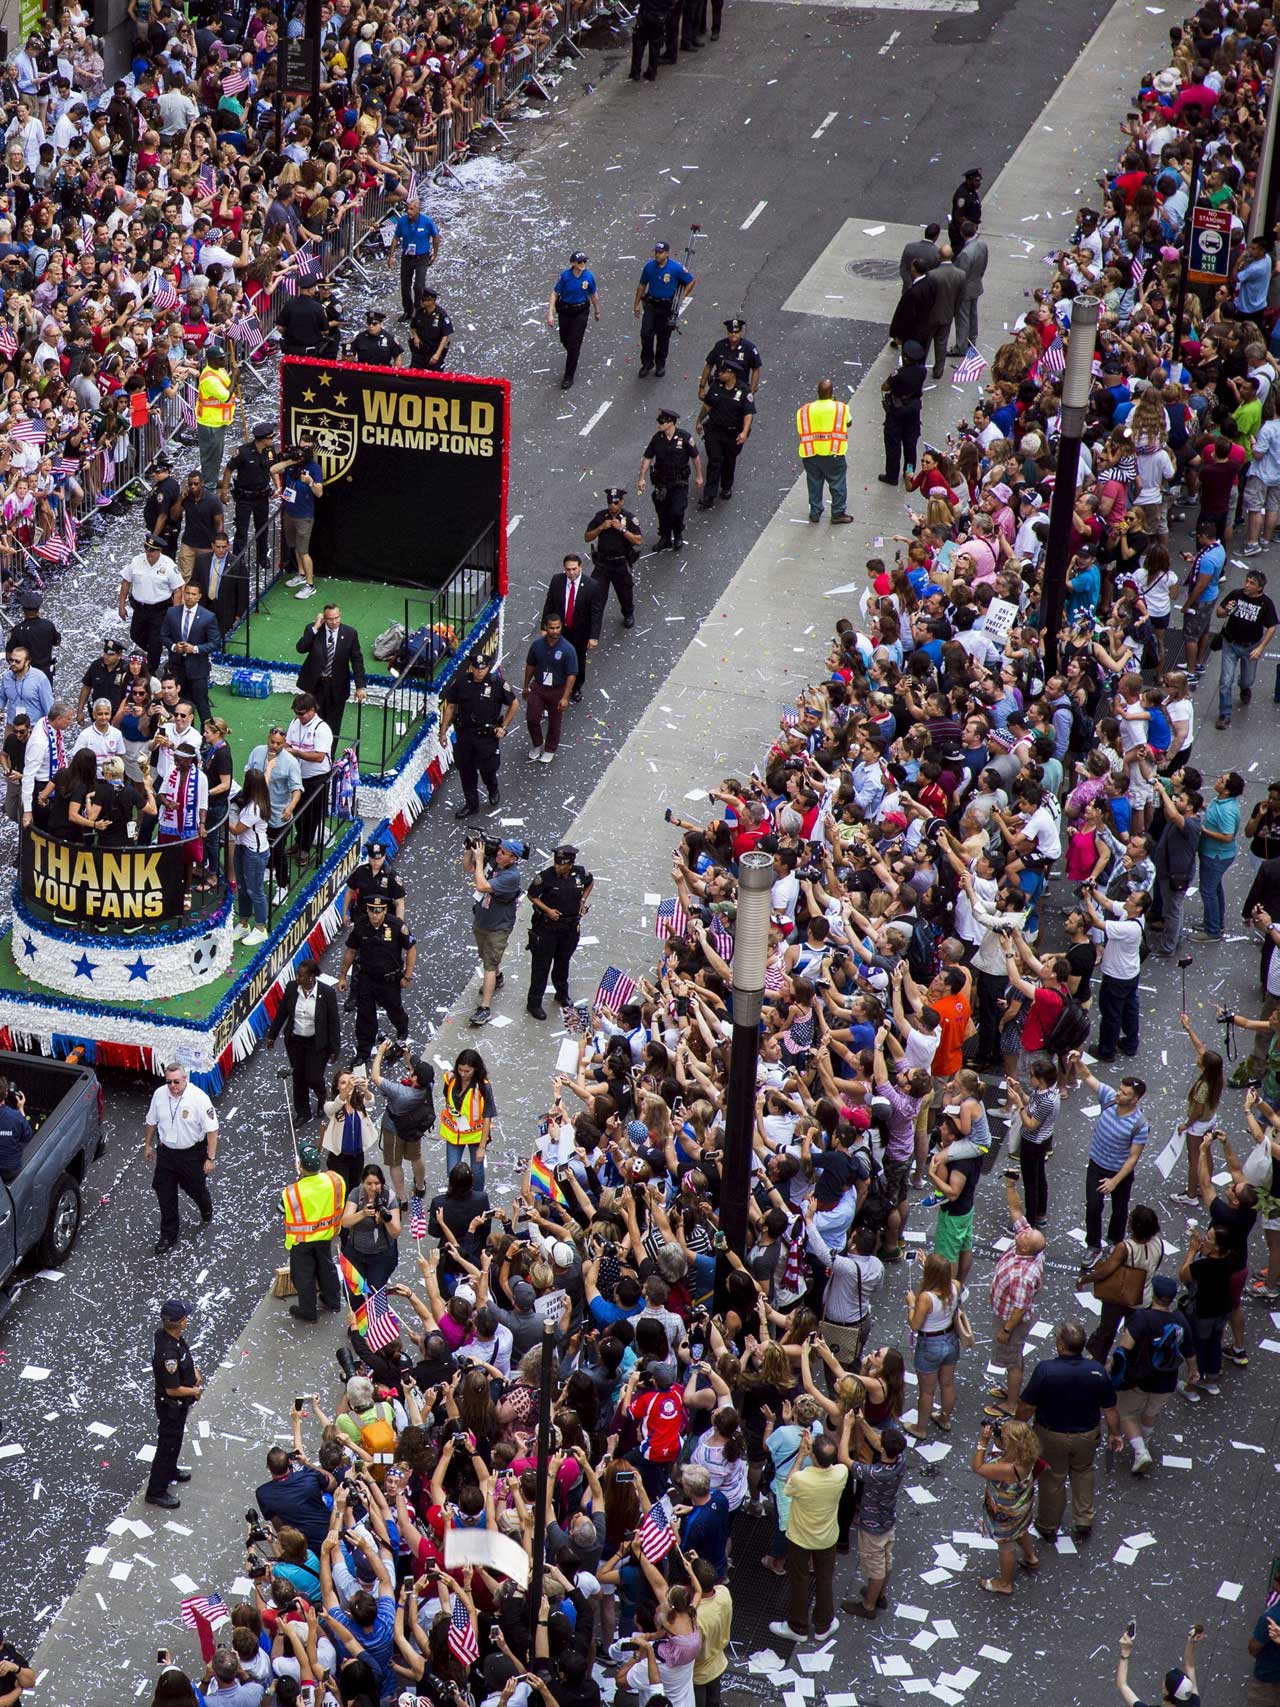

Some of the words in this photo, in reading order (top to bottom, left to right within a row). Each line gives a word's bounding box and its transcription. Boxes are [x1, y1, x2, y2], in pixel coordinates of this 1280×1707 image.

[1201, 253, 1217, 263] X10
[1201, 262, 1216, 271] X11
[361, 389, 495, 436] WORLD
[361, 425, 494, 457] CHAMPIONS
[30, 831, 163, 891] THANK
[33, 870, 77, 912] YOU
[85, 890, 164, 919] FANS
[248, 970, 269, 1006] ONE
[311, 888, 329, 922] ONE
